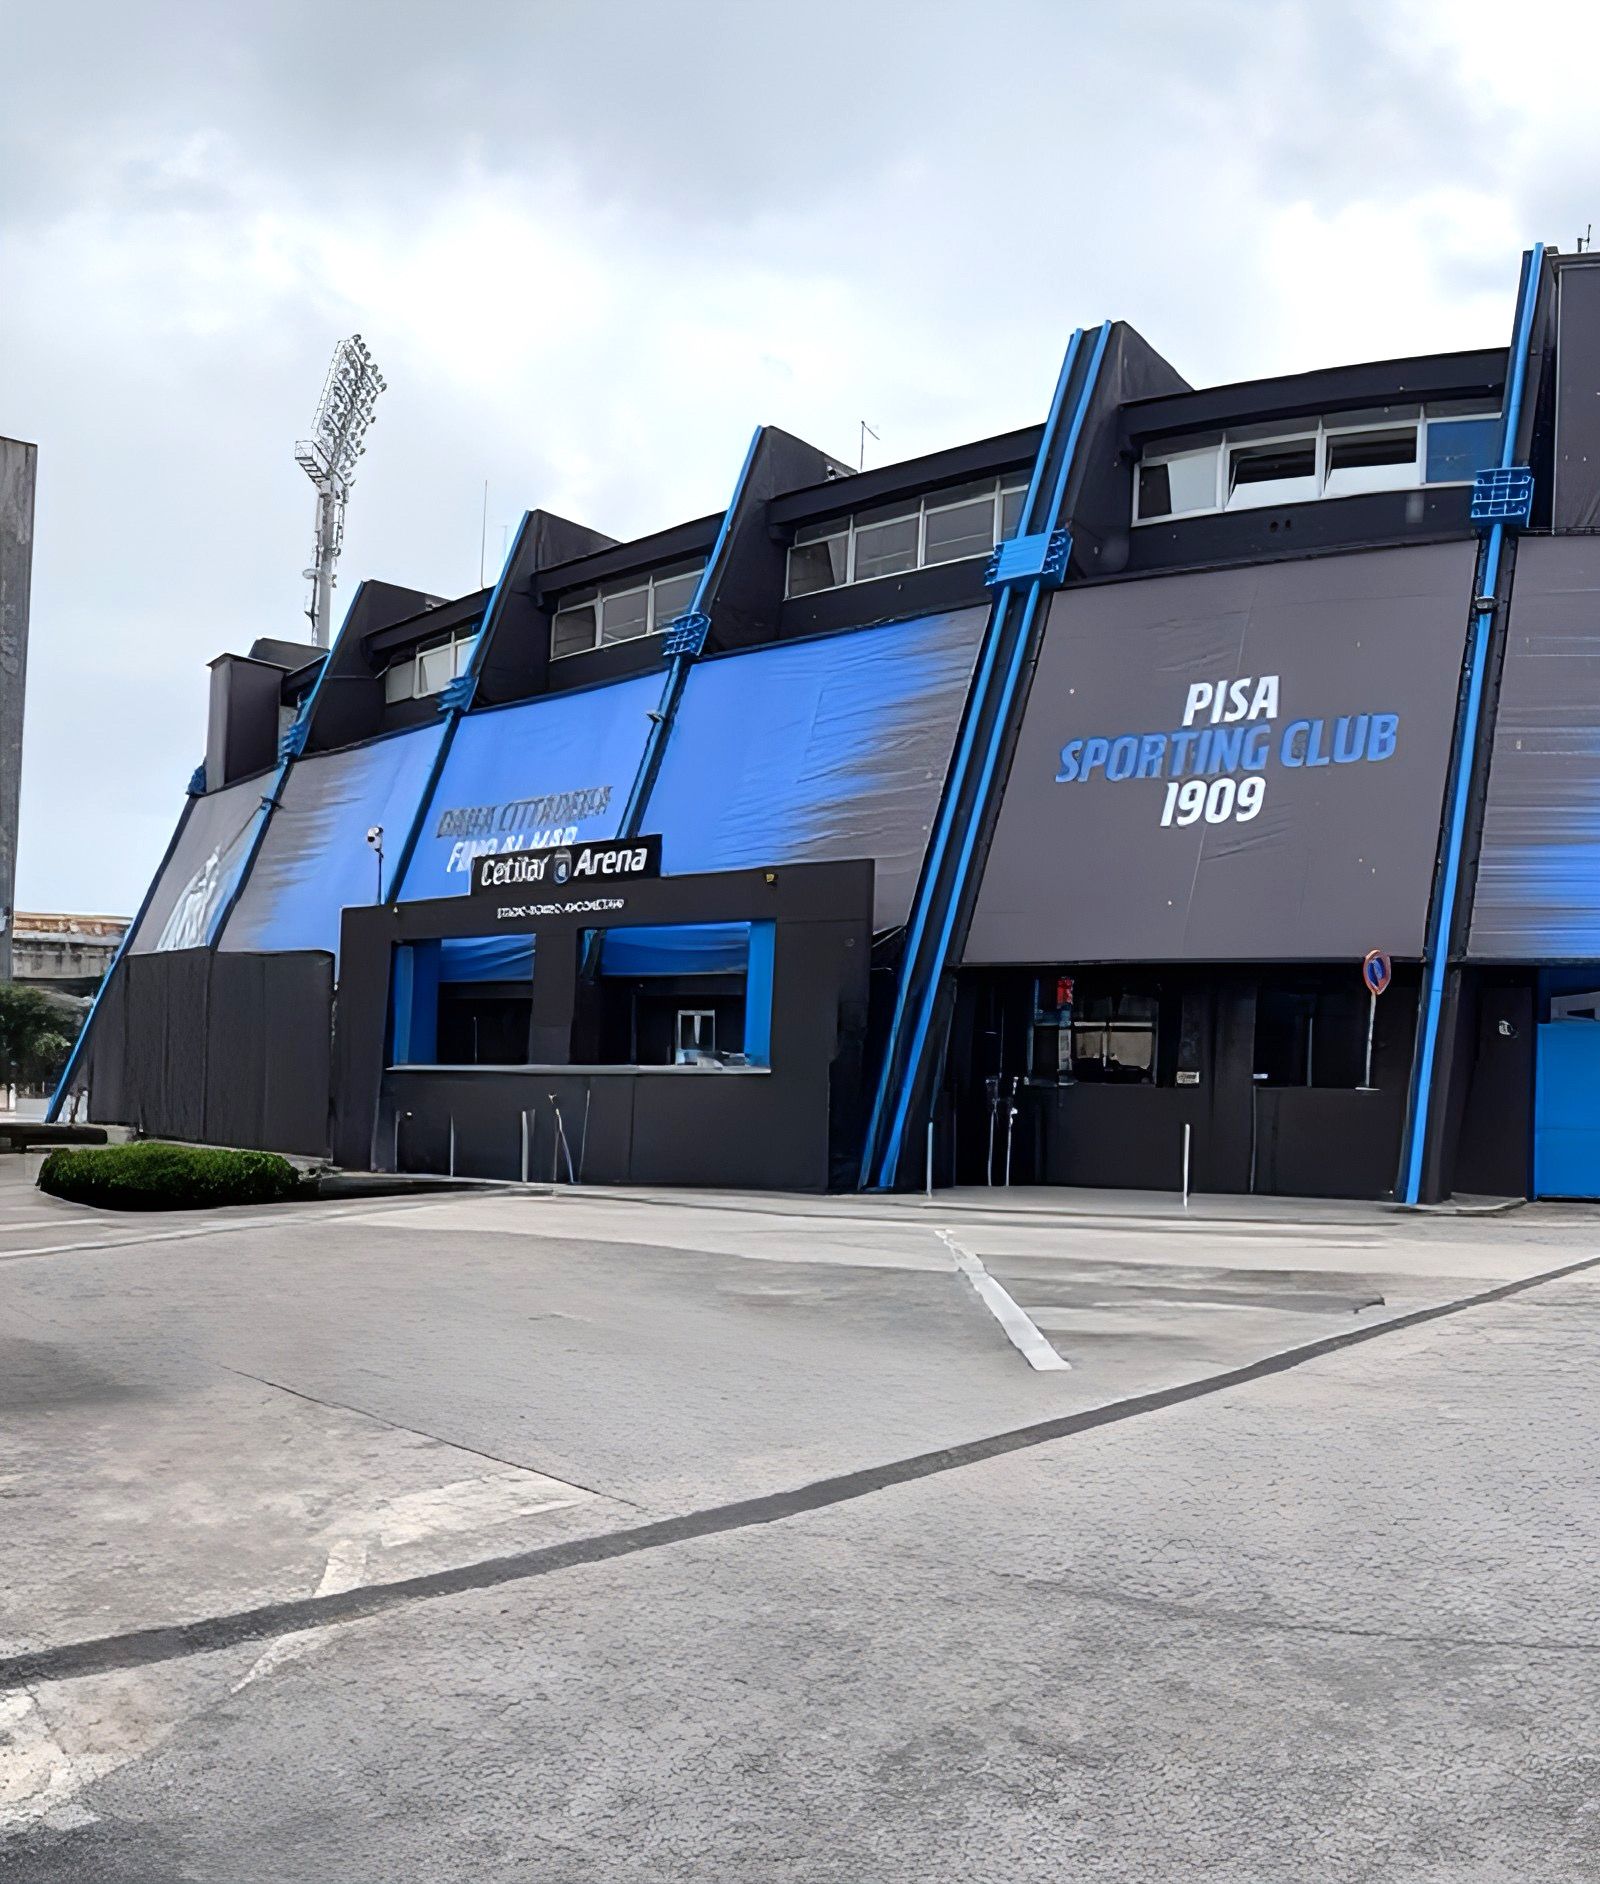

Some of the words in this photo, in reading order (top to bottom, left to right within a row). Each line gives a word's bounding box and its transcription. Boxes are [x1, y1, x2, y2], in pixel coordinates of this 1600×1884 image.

[1182, 675, 1280, 726] PISA
[1055, 724, 1272, 783] SPORTING
[1279, 713, 1399, 768] CLUB
[1160, 776, 1266, 828] 1909
[573, 848, 648, 877] Arena
